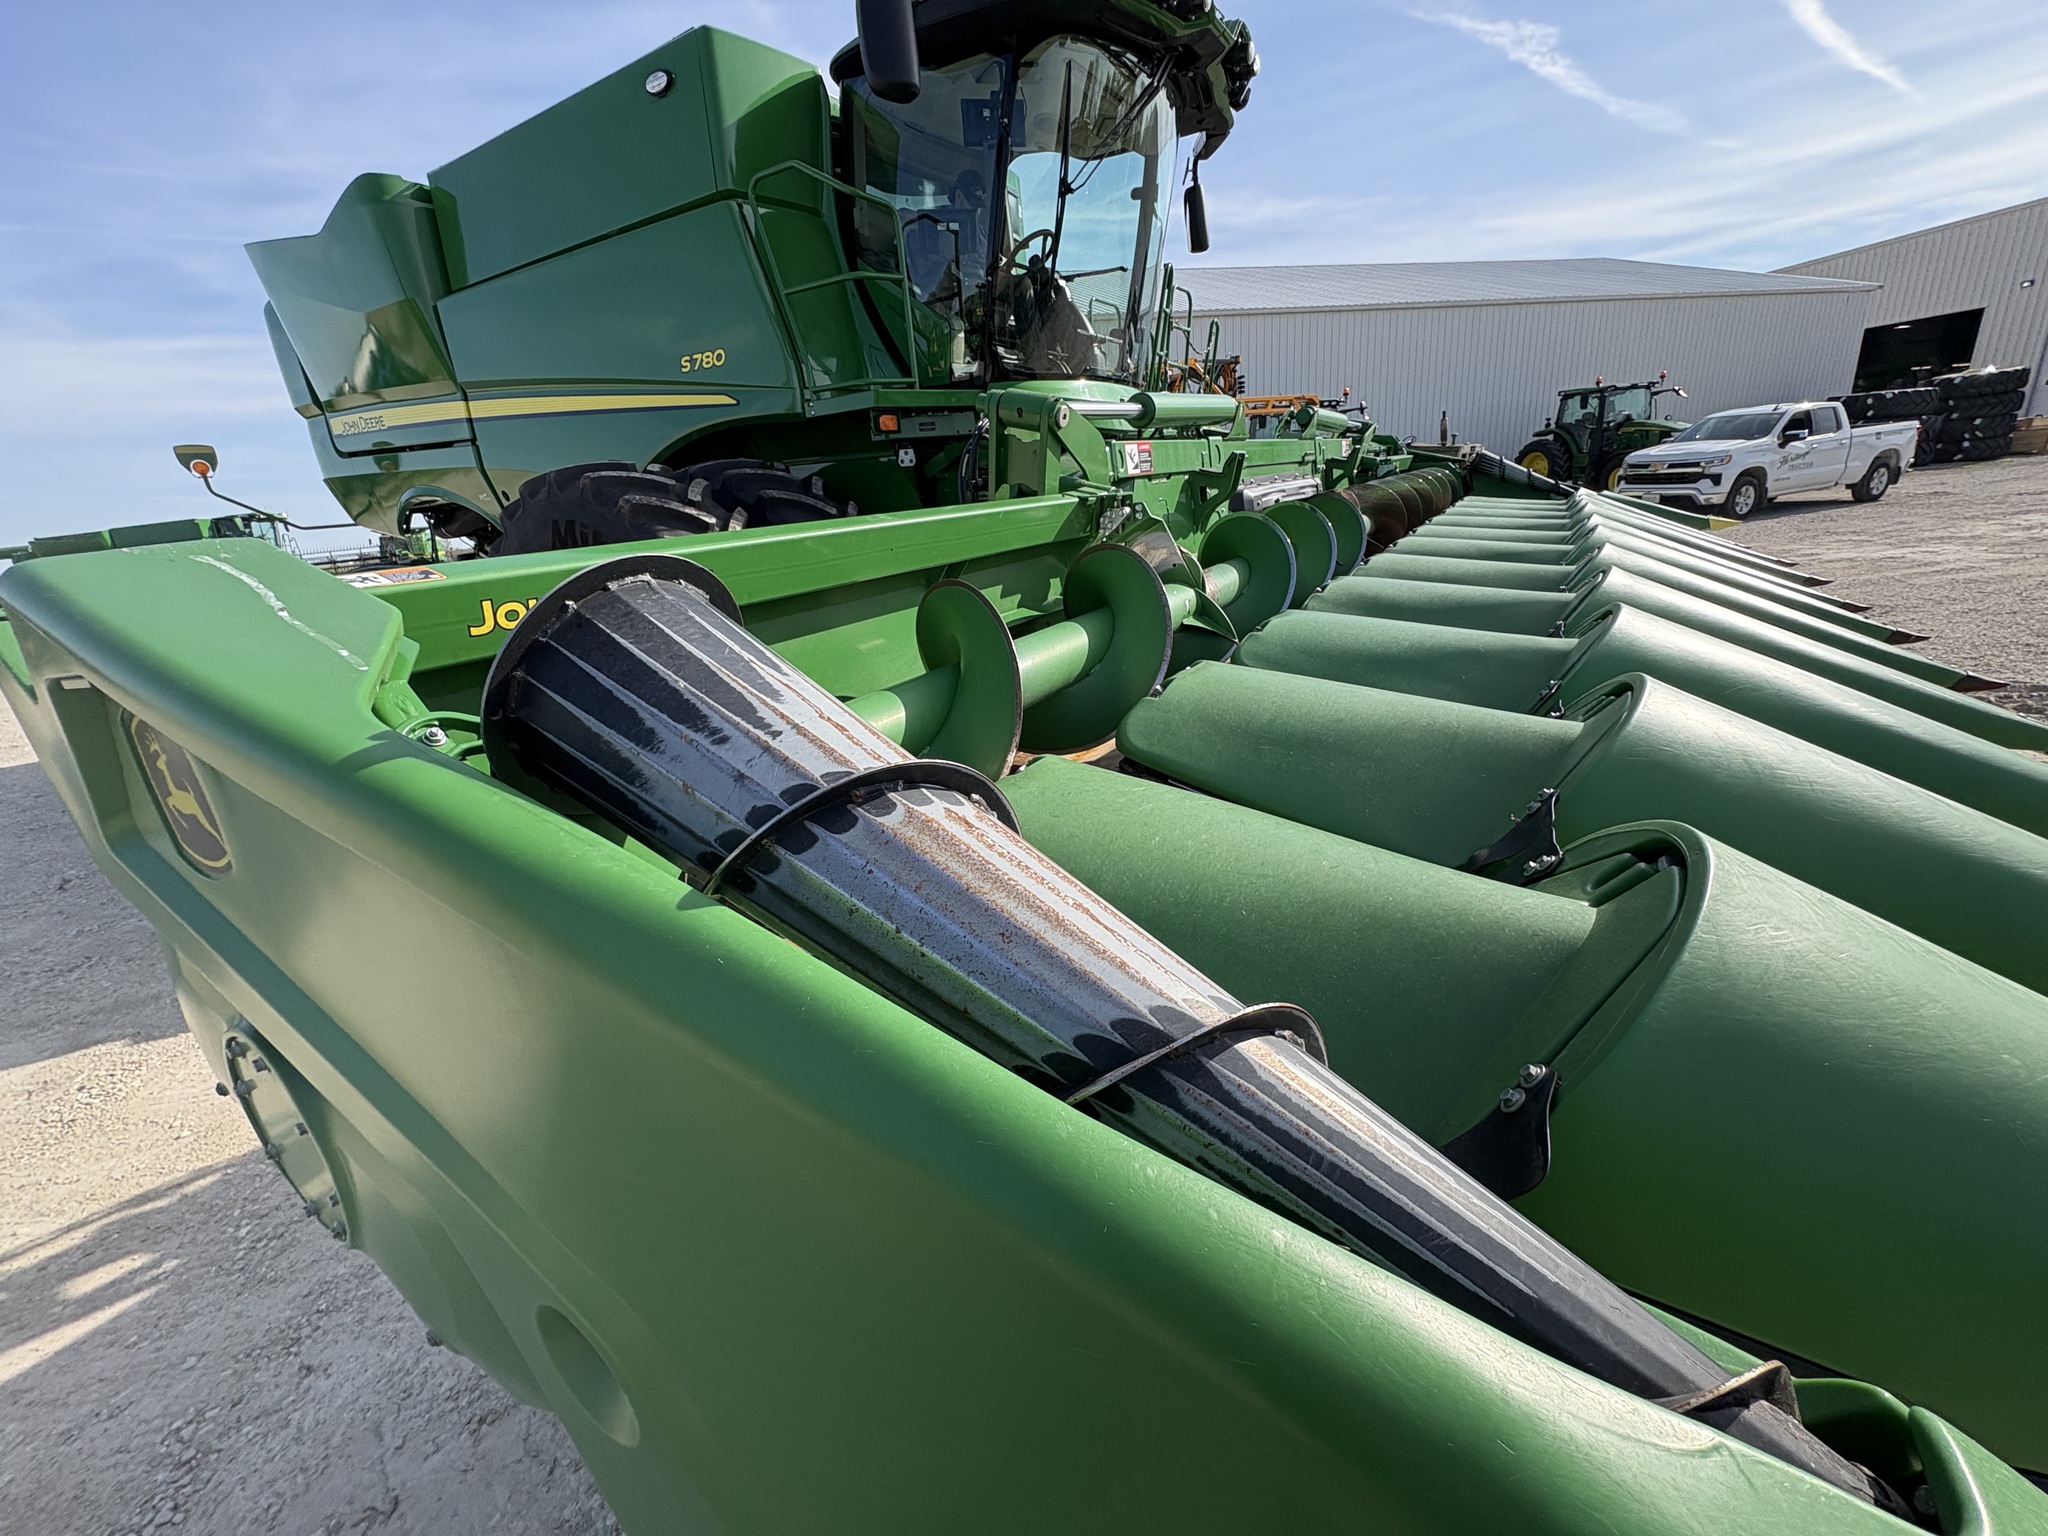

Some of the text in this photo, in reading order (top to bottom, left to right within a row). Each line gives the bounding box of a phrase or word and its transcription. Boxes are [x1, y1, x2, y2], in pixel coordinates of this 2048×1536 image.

[341, 415, 386, 434] JOHN DEERE
[467, 597, 538, 637] JO
